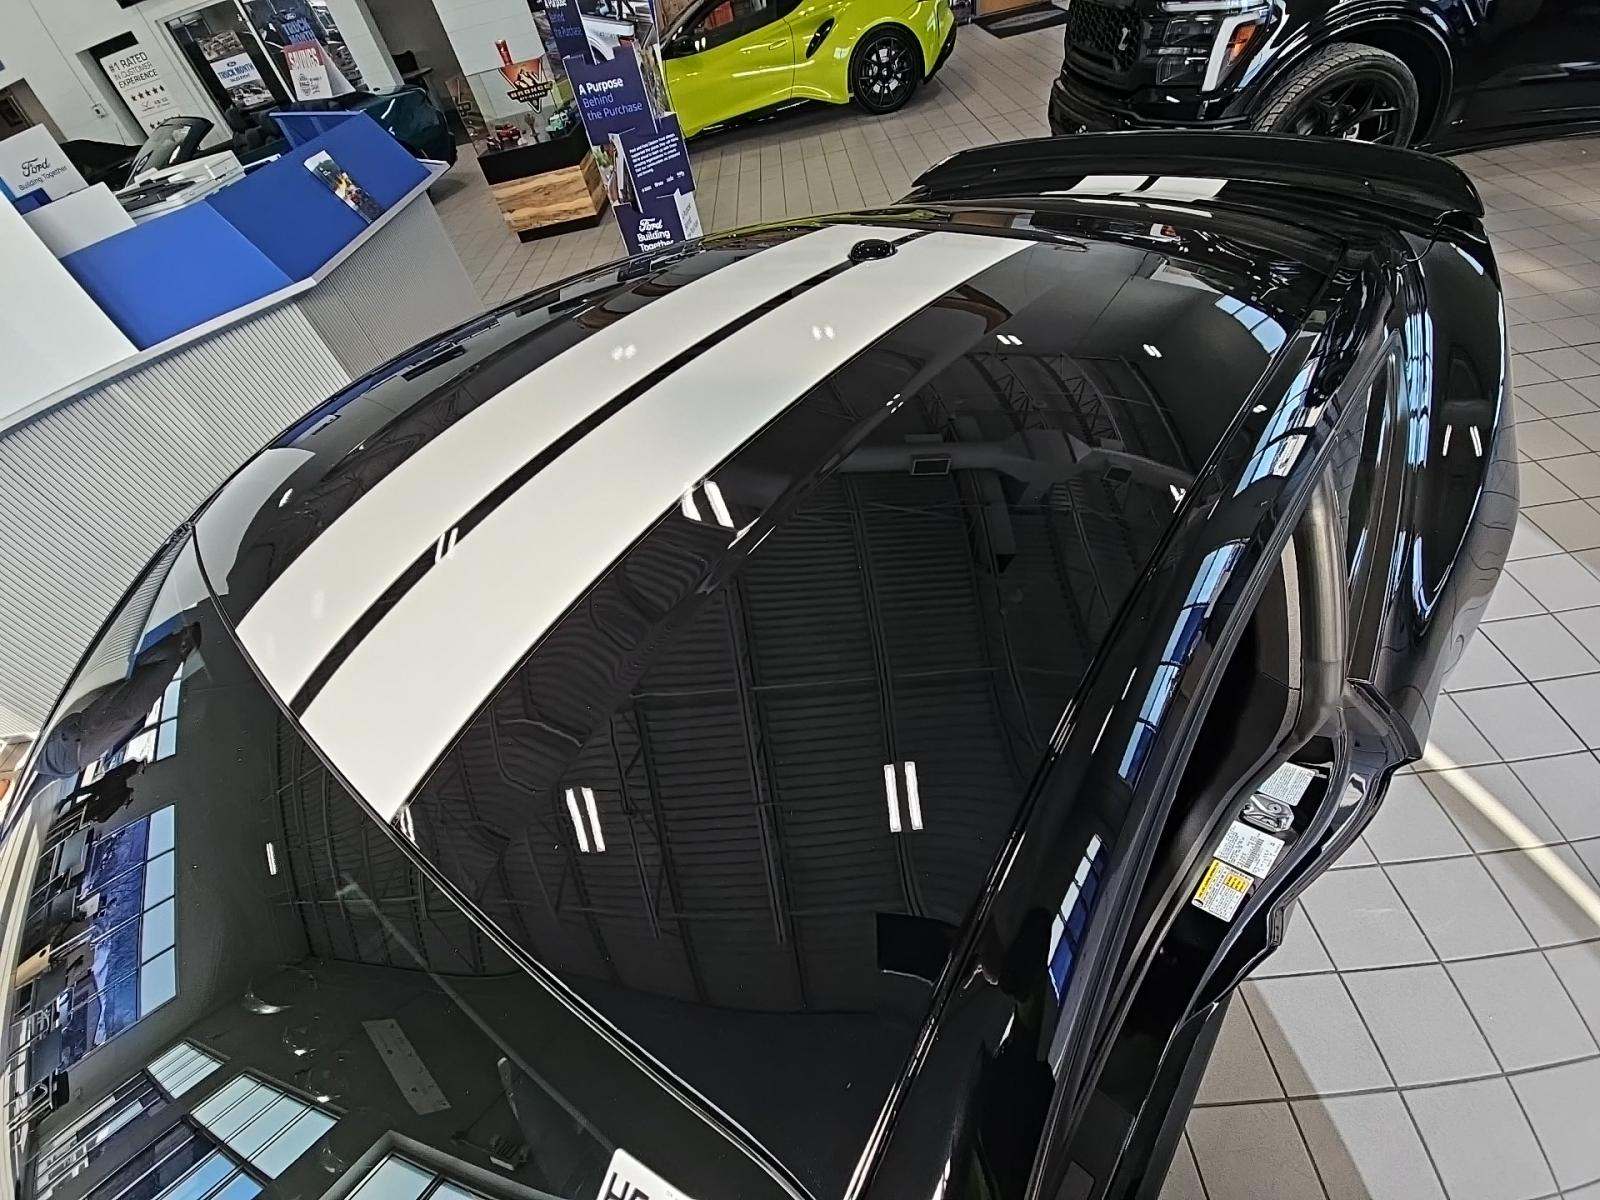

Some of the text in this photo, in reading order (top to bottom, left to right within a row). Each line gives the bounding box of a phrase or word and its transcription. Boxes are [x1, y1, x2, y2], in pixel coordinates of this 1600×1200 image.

[282, 18, 311, 36] TRUCK
[288, 29, 316, 43] MONTH
[108, 51, 148, 72] #1 RATED
[121, 61, 153, 79] CUSTOMER
[118, 68, 158, 88] EXPERIENCE
[217, 63, 255, 80] TRUCK MONTH
[511, 84, 551, 98] BRONCO
[579, 78, 624, 95] A Purpose
[582, 92, 614, 108] Behind
[587, 102, 643, 121] the Purchase
[21, 157, 50, 177] Ford
[18, 165, 67, 191] Building Together
[638, 217, 664, 232] Ford
[637, 230, 671, 242] Building
